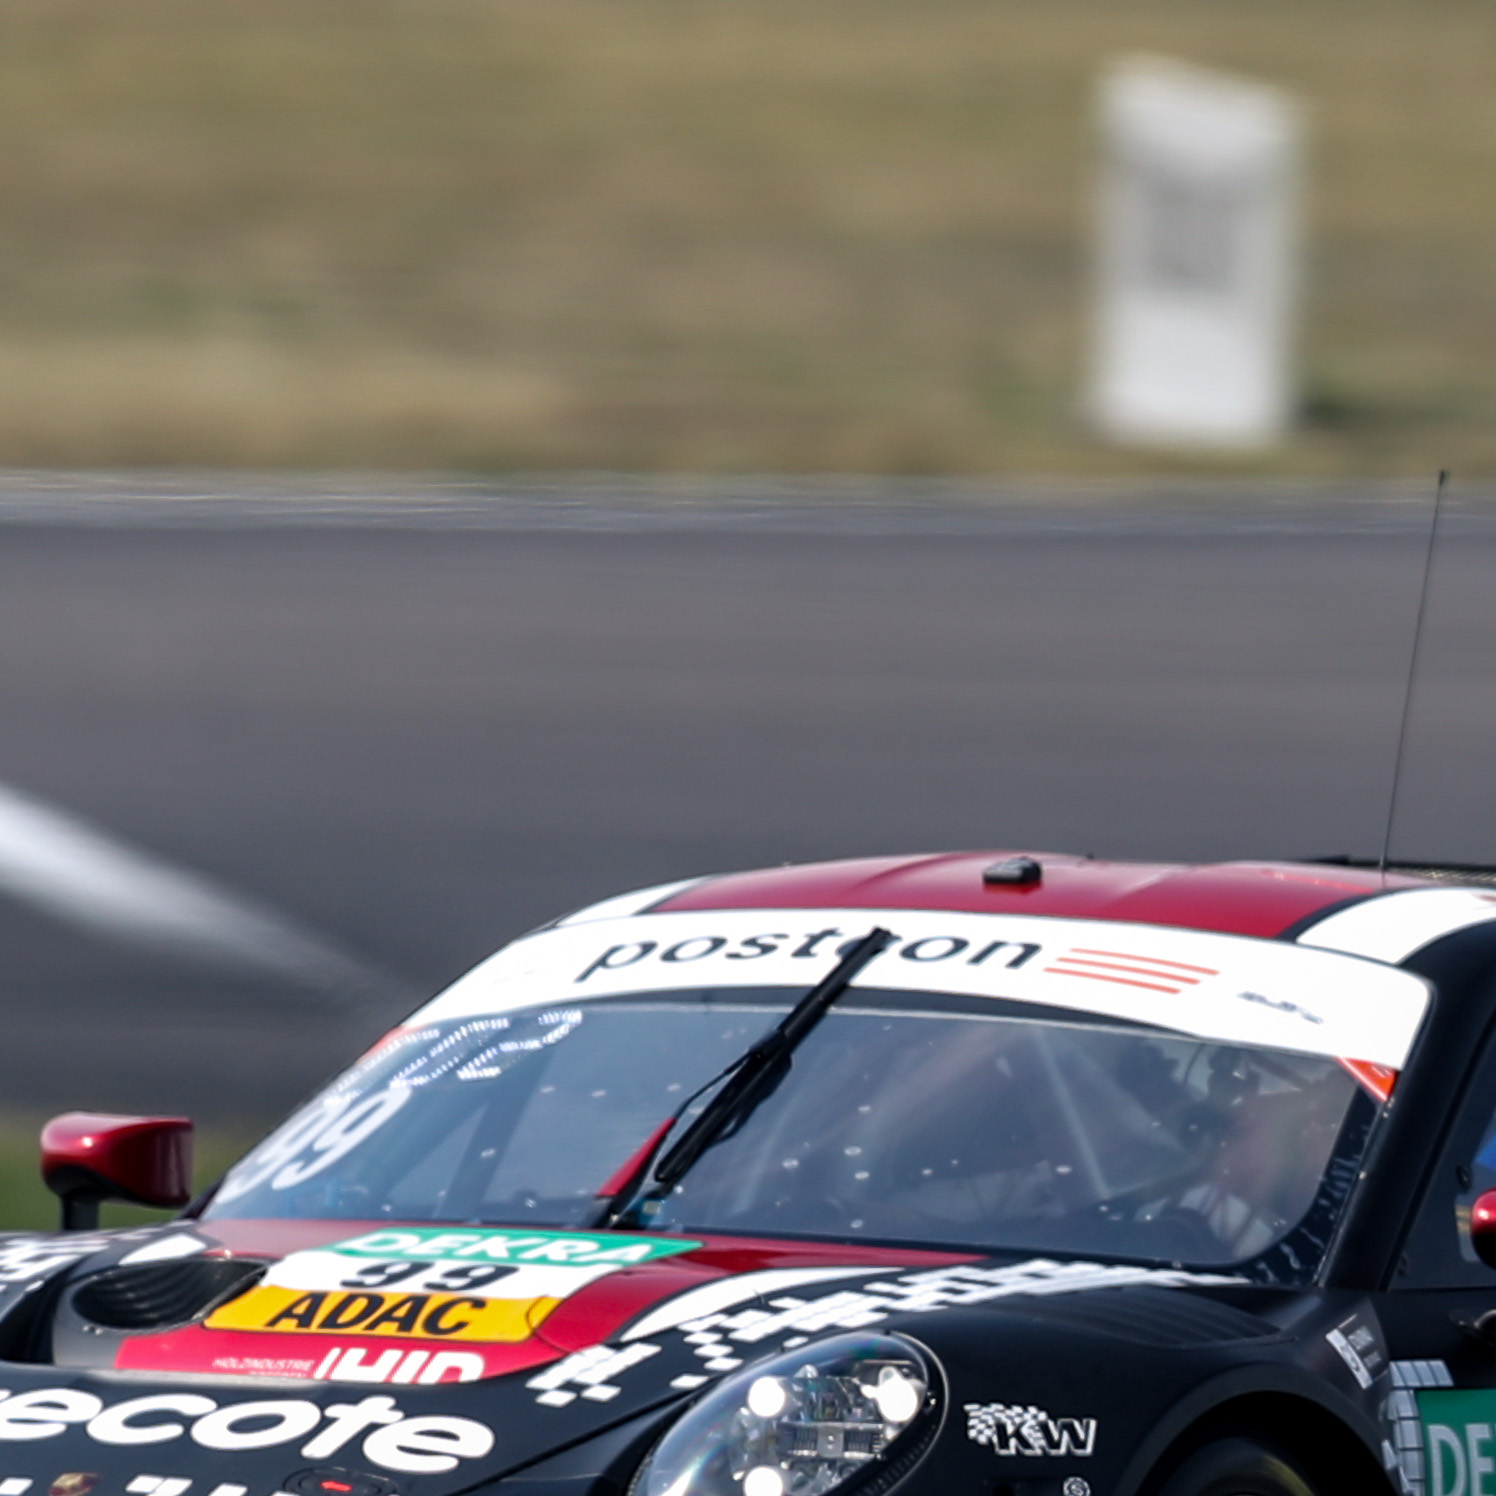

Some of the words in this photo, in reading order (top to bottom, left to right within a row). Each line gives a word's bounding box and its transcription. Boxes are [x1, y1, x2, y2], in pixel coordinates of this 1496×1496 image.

[214, 1083, 412, 1204] 99
[346, 1232, 654, 1263] DEKRA
[340, 1262, 518, 1291] 99
[265, 1292, 487, 1335] ADAC
